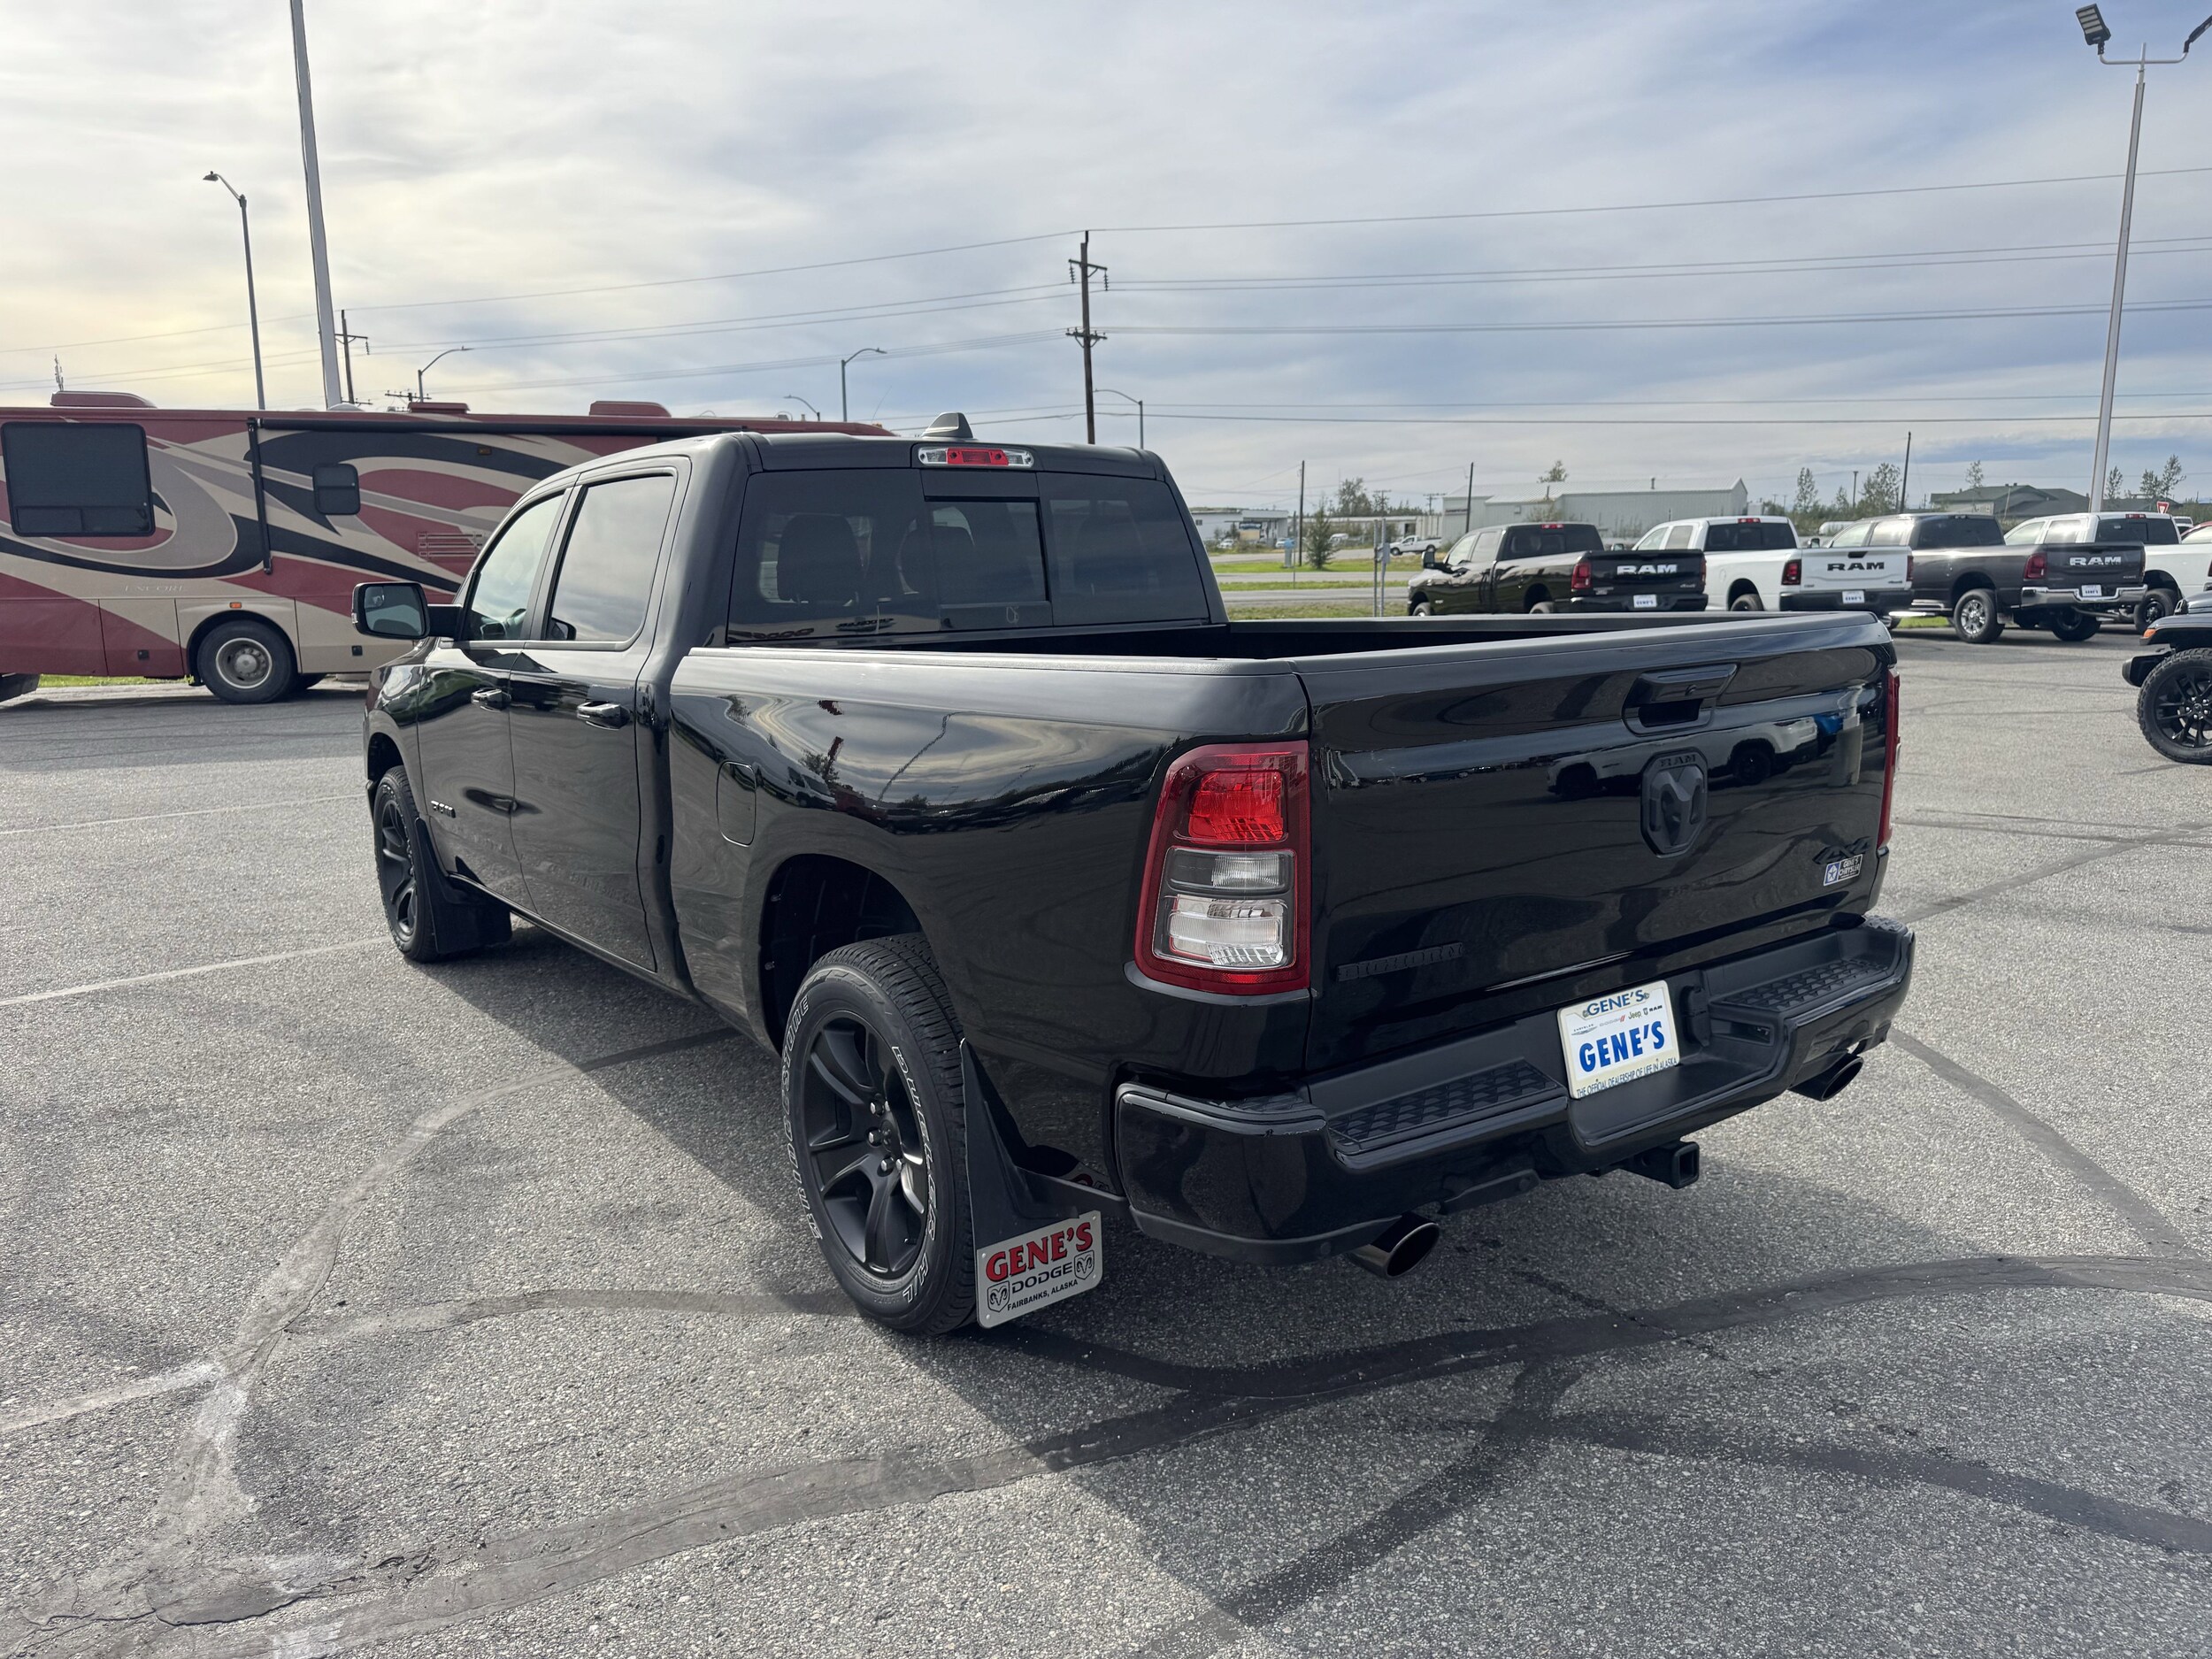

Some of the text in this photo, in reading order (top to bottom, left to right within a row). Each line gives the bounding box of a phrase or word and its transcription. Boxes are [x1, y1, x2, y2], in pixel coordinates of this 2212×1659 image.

[1617, 564, 1678, 575] RAM
[1827, 562, 1885, 571] RAM
[2070, 557, 2121, 565] RAM
[1660, 755, 1696, 766] RAM
[1586, 989, 1645, 1016] GENE'S
[1628, 1010, 1642, 1019] Jeep
[1578, 1021, 1665, 1072] GENE'S
[1576, 1057, 1678, 1097] THE OFFICIAL DEALERSHIP OF LIFE IN ALASKA
[986, 1222, 1094, 1282] GENE'S
[1011, 1262, 1073, 1294] DODGE
[1007, 1279, 1079, 1311] FAIRBANKS, ALASKA
